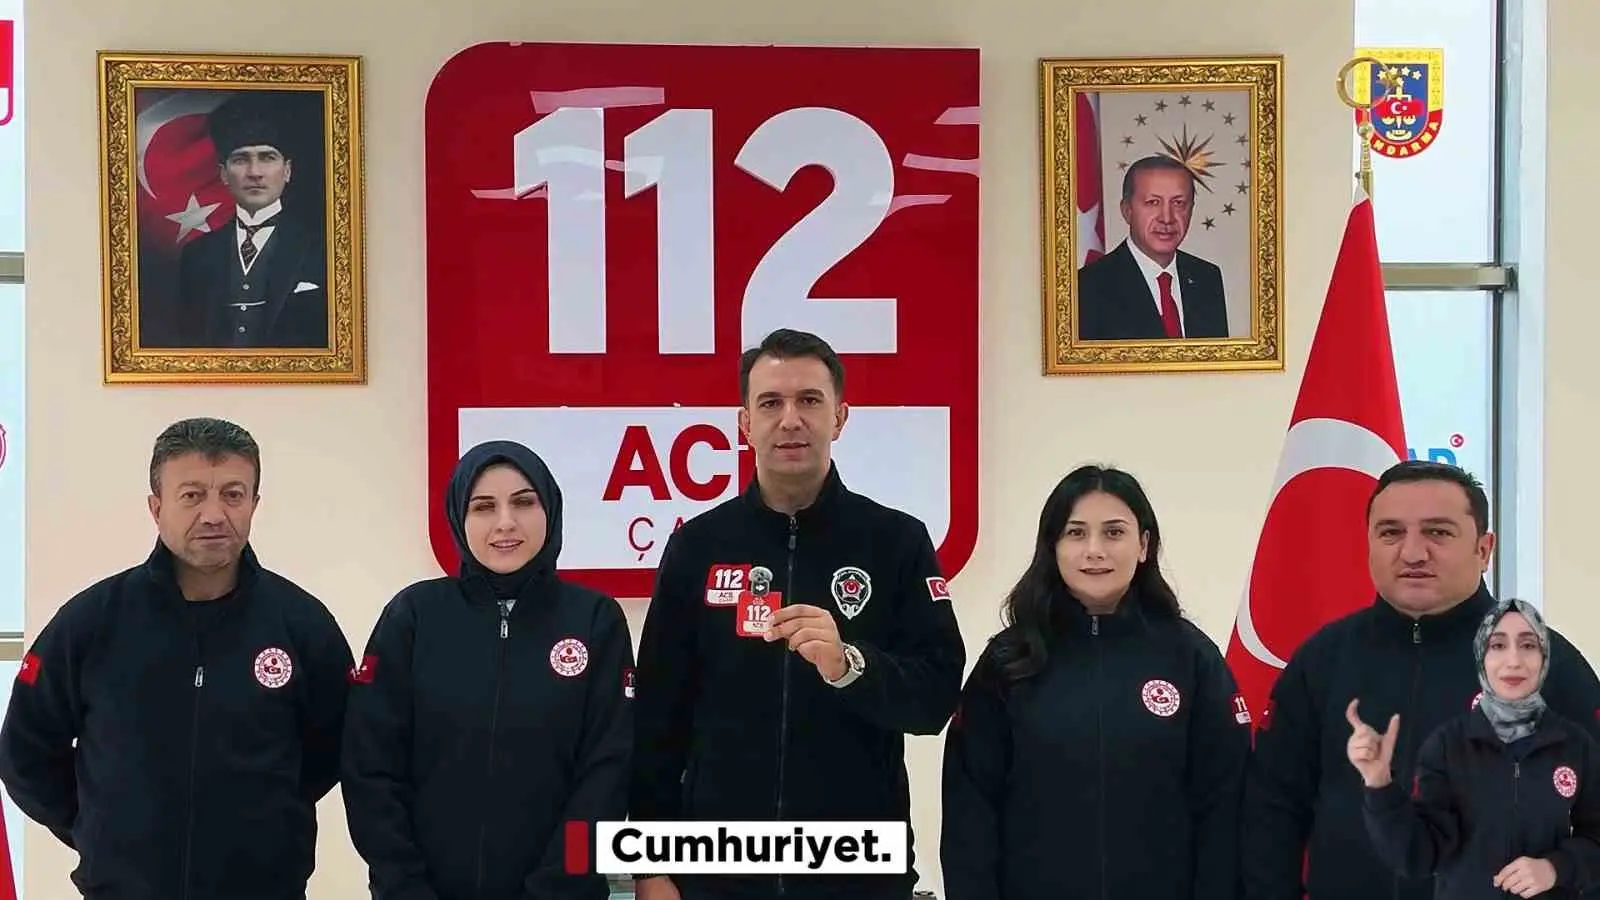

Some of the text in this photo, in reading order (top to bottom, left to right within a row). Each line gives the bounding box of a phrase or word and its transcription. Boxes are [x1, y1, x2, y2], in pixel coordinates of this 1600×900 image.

[1373, 121, 1440, 156] NDARMA
[513, 107, 898, 354] 112
[602, 424, 757, 501] ACİ
[715, 569, 744, 589] 112
[746, 605, 771, 621] 112
[1234, 696, 1248, 712] 11
